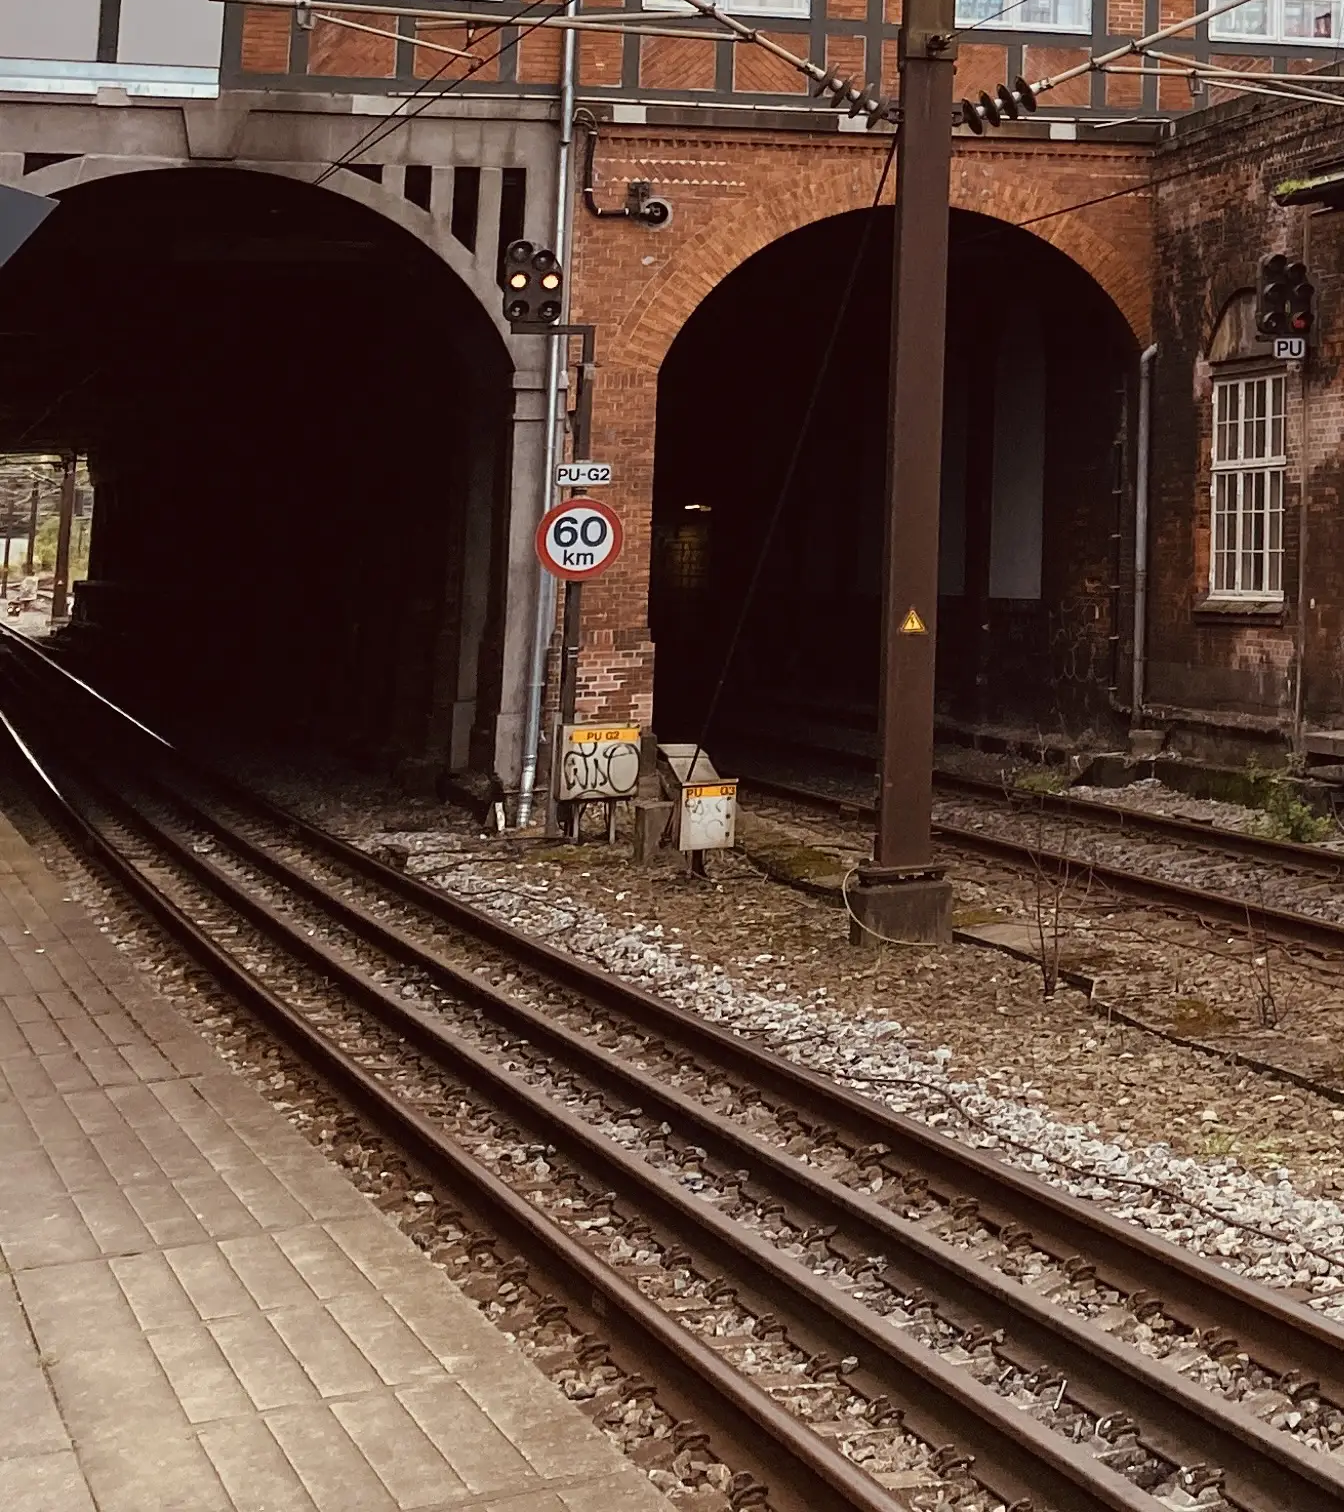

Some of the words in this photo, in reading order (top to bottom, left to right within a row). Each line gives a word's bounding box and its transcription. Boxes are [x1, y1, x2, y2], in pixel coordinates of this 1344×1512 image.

[1277, 340, 1303, 357] PU
[557, 467, 610, 482] PU-G2
[553, 515, 608, 548] 60
[562, 549, 594, 566] km
[586, 731, 603, 742] PU
[686, 787, 703, 799] PU
